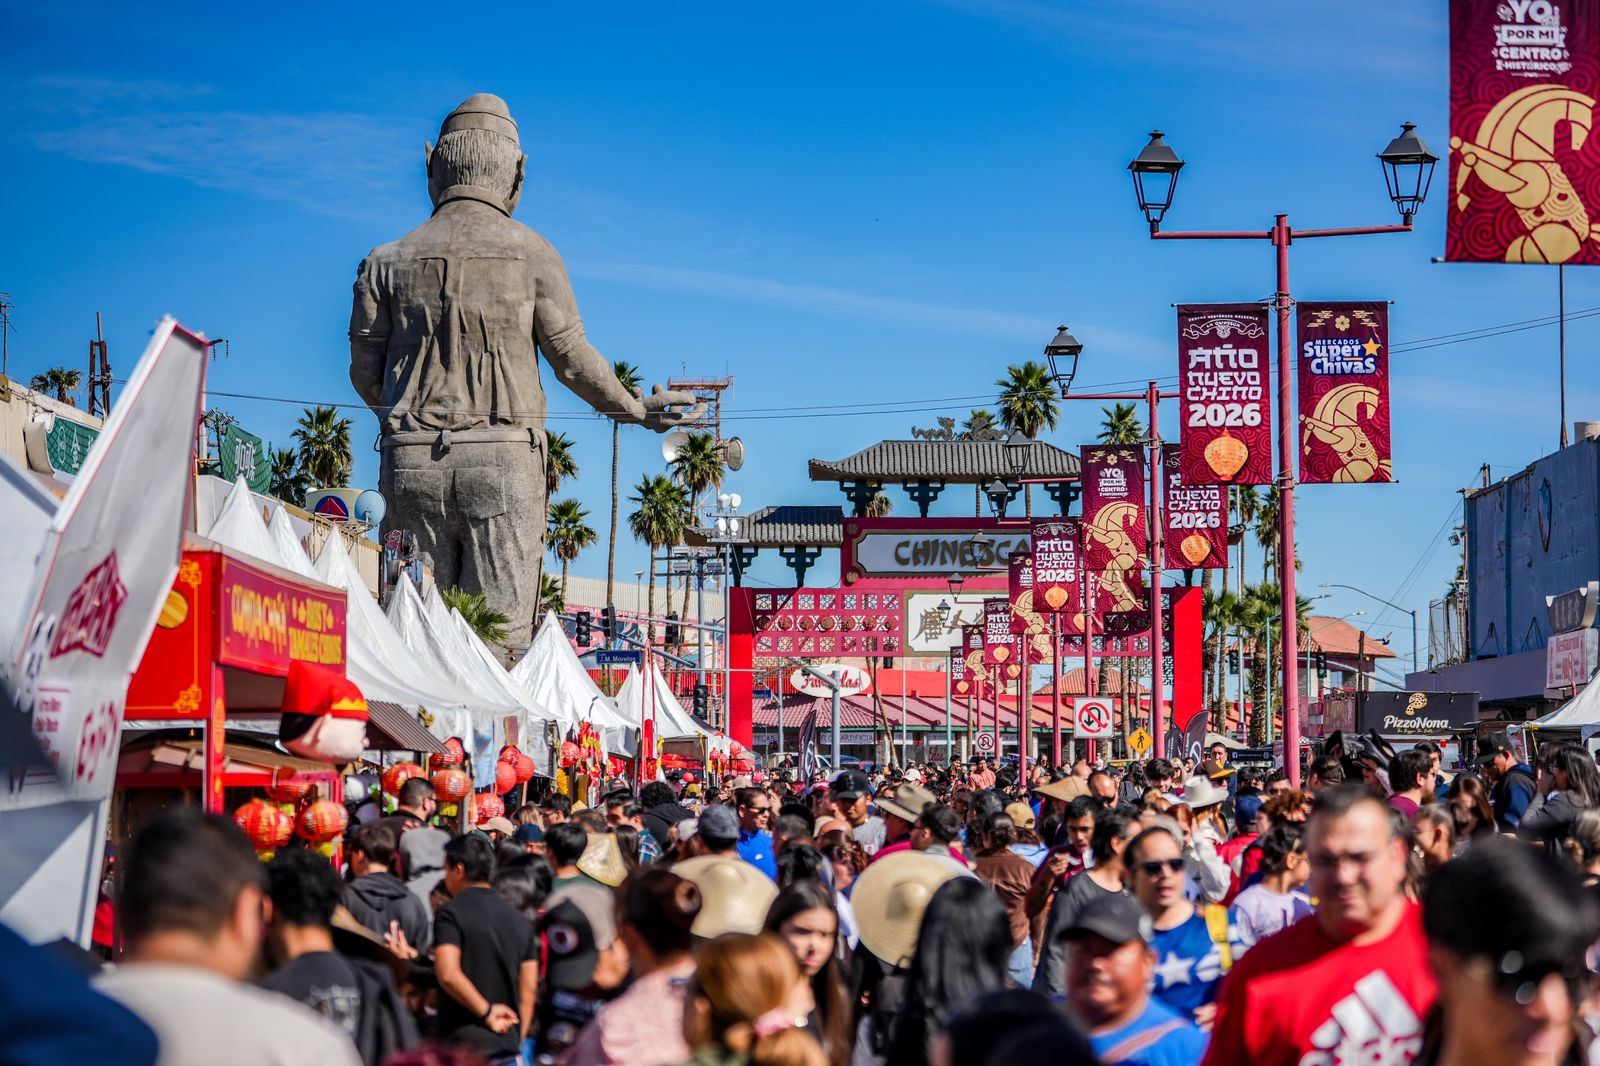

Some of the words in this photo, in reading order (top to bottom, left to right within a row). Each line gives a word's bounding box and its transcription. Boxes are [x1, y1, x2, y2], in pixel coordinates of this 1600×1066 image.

[1507, 0, 1553, 23] YO
[1507, 30, 1535, 39] POR
[1539, 30, 1555, 39] MI
[1499, 47, 1563, 60] CENTRO
[1188, 343, 1259, 369] AÑO
[1303, 341, 1361, 361] Super
[1310, 356, 1376, 374] Chivas
[1187, 371, 1261, 387] NUEVO
[1187, 386, 1263, 401] CHINO
[1188, 402, 1262, 427] 2026
[1103, 467, 1121, 478] YO
[1169, 490, 1220, 500] NUEVO
[1168, 499, 1221, 511] CHINO
[1169, 511, 1221, 529] 2026
[1035, 538, 1074, 552] AÑO
[1035, 552, 1075, 561] NUEVO
[1035, 560, 1076, 569] CHINO
[1036, 569, 1076, 582] 2026
[987, 634, 1015, 644] 2026
